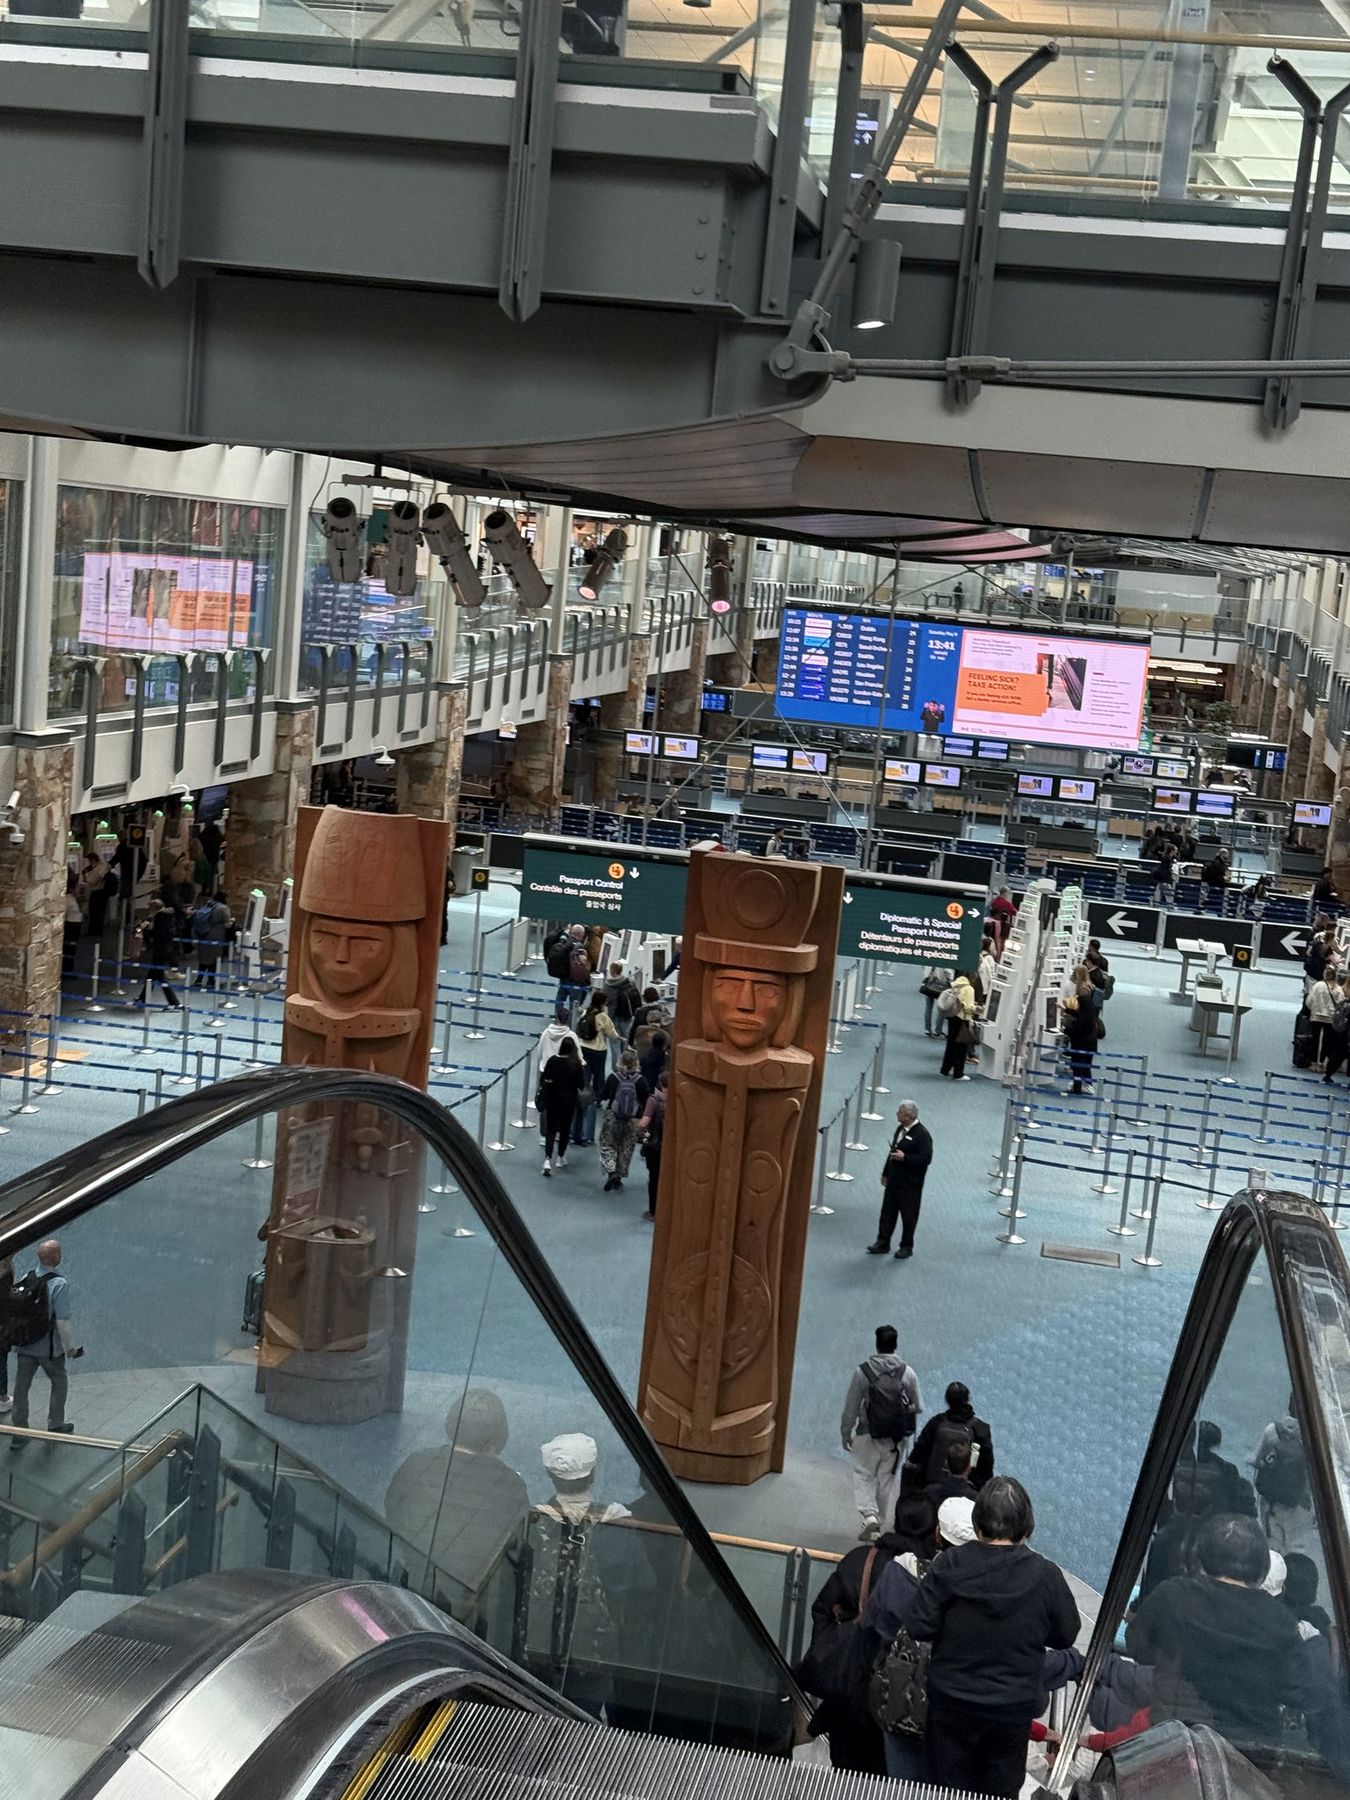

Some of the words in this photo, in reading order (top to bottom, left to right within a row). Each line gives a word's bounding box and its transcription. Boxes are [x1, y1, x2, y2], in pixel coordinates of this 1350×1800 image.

[927, 639, 956, 650] 13:41
[968, 680, 986, 689] TAKE
[988, 682, 1017, 691] ACTION!
[969, 672, 997, 682] FEELING
[999, 675, 1020, 684] SICK?
[559, 875, 593, 886] Passport
[595, 879, 623, 889] Control
[530, 883, 562, 894] Contrôle
[564, 887, 578, 895] des
[579, 890, 622, 900] passeports
[880, 912, 922, 926] Diplomatic
[923, 918, 930, 926] &
[932, 919, 962, 930] Special
[892, 924, 928, 936] Passport
[929, 928, 960, 940] Holders
[861, 931, 902, 943] Détenteurs
[916, 938, 959, 950] passeports
[858, 942, 912, 955] diplomatiques
[923, 950, 958, 960] spéciaux
